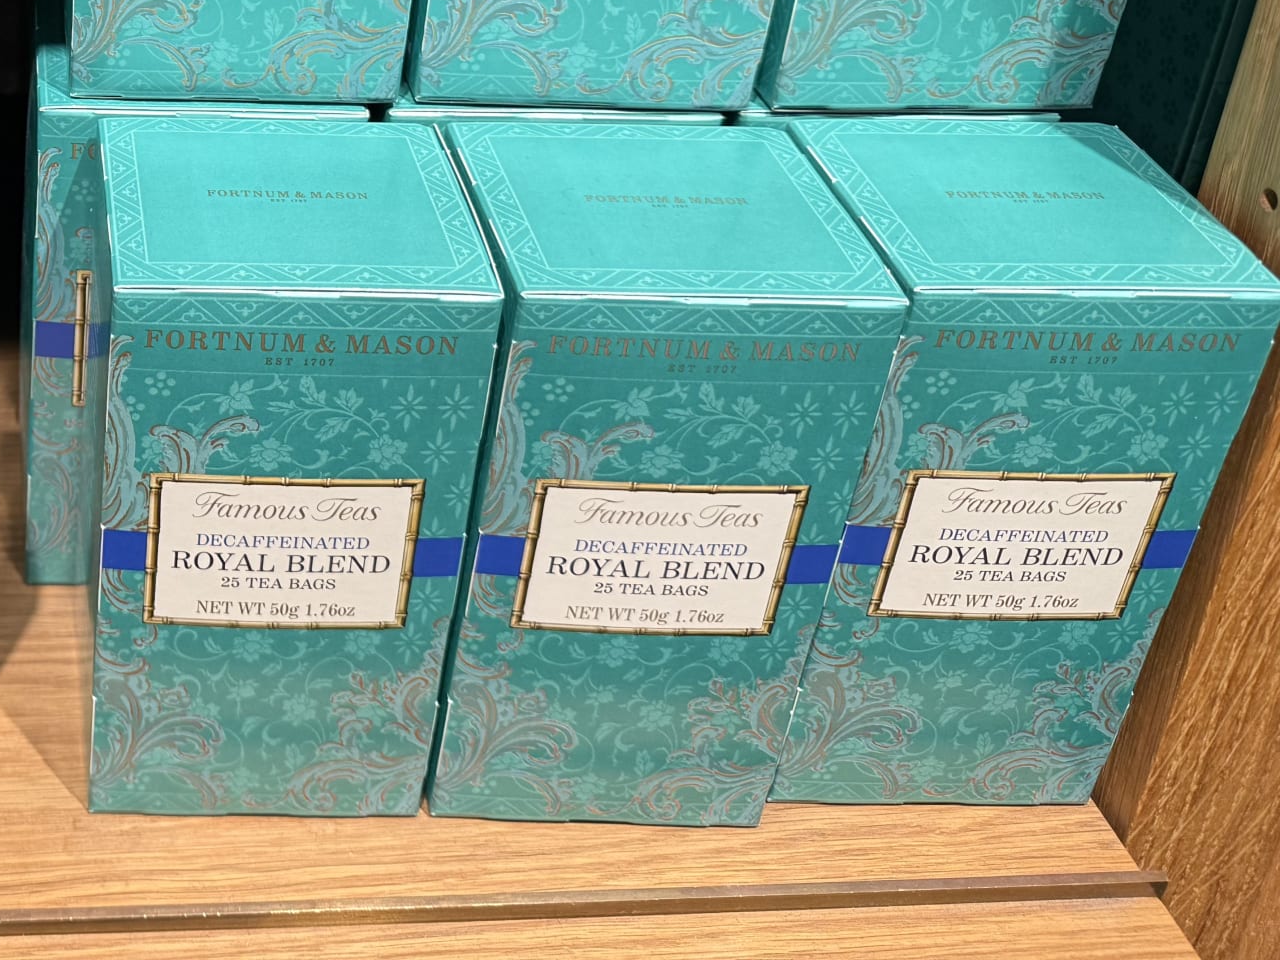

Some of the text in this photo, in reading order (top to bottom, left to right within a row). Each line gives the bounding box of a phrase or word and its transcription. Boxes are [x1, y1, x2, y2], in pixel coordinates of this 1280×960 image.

[143, 329, 459, 356] FORTNUM & MASON
[547, 335, 862, 362] FORTNUM & MASON
[935, 329, 1242, 353] FORTNUM & MASON
[264, 357, 294, 366] EST
[192, 491, 381, 521] Famous Teas
[942, 487, 1127, 516] Famous Teas
[576, 497, 763, 528] Famous Teas
[196, 533, 370, 550] DECAFFEINATED
[939, 528, 1109, 543] DECAFFEINATED
[574, 539, 748, 556] DECAFFEINATED
[908, 545, 1123, 566] ROYAL BLEND
[171, 550, 390, 574] ROYAL BLEND
[546, 556, 765, 580] ROYAL BLEND
[221, 576, 336, 590] 25 TEA BAGS
[953, 570, 1067, 582] 25 TEA BAGS
[593, 582, 709, 596] 25 TEA BAGS
[196, 600, 355, 619] NET WT 50g 1.76oz
[922, 593, 1079, 611] NET WT 50g 1.76oz
[565, 605, 724, 625] NET WT 50g 1.76oz
